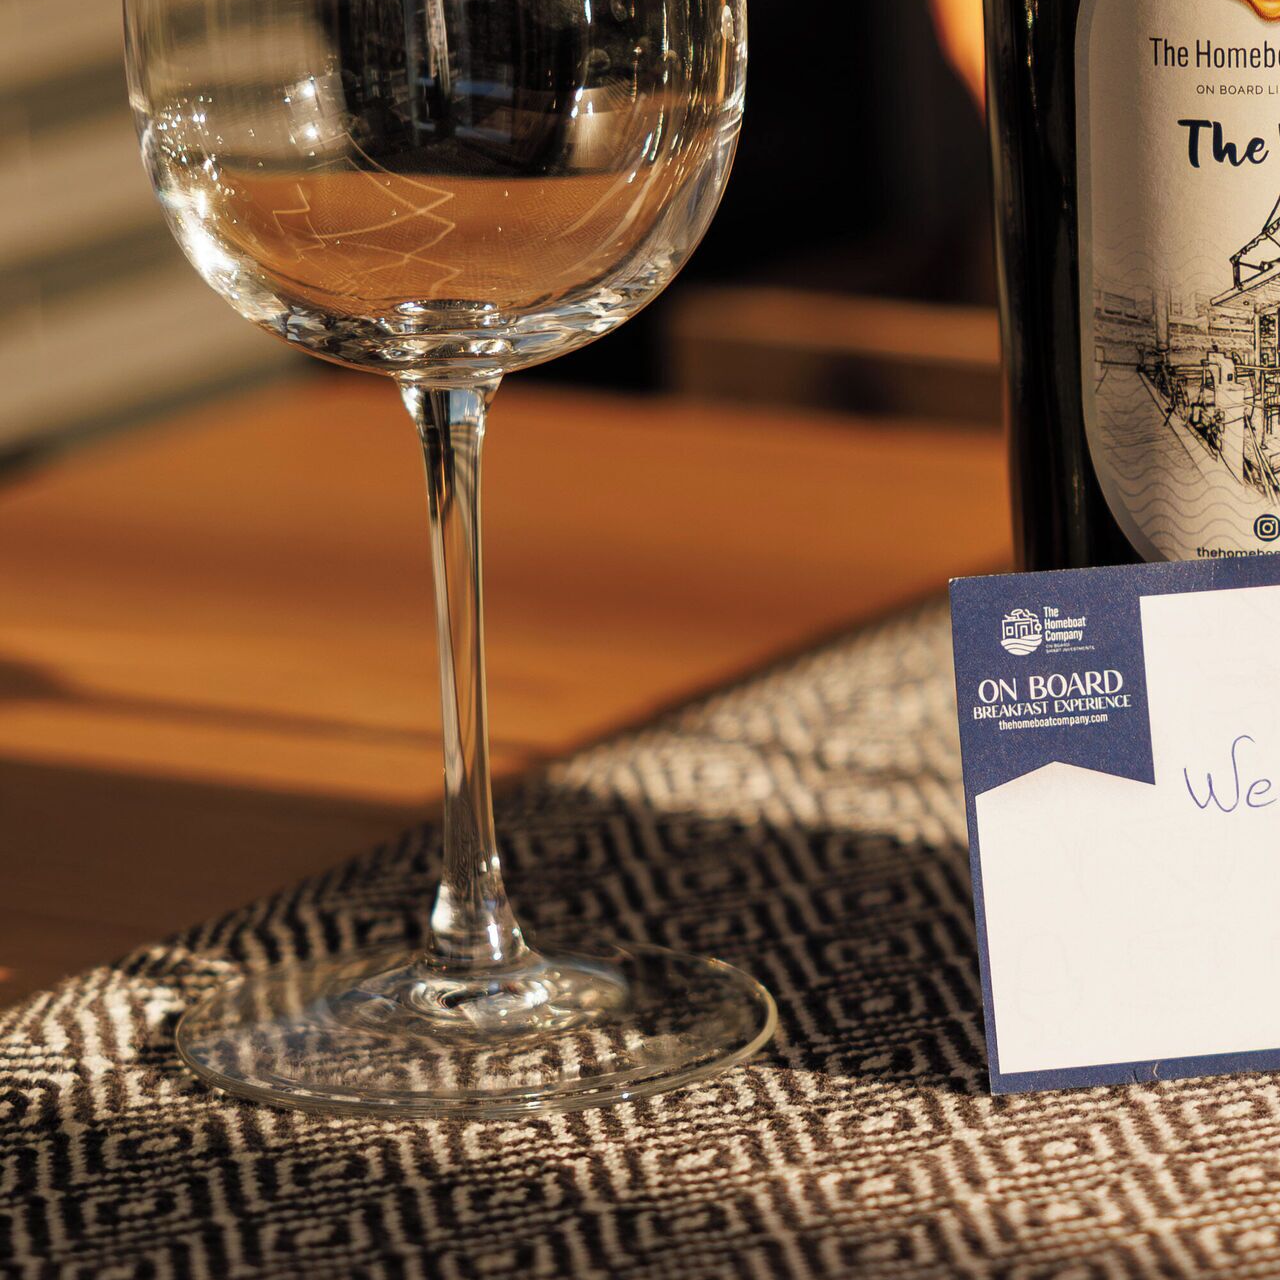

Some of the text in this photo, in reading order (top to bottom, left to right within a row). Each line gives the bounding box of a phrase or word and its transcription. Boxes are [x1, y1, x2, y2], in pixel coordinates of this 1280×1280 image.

[1149, 37, 1189, 68] The
[1196, 84, 1215, 95] ON
[1219, 84, 1264, 96] BOARD
[1177, 119, 1269, 168] The
[1043, 606, 1059, 618] The
[1044, 616, 1087, 630] Homeboat
[1045, 629, 1083, 642] Company
[978, 669, 1124, 704] ON BOARD
[973, 694, 1132, 720] BREAKFAST EXPERIENCE
[999, 713, 1108, 731] thehomeboatcompany.com
